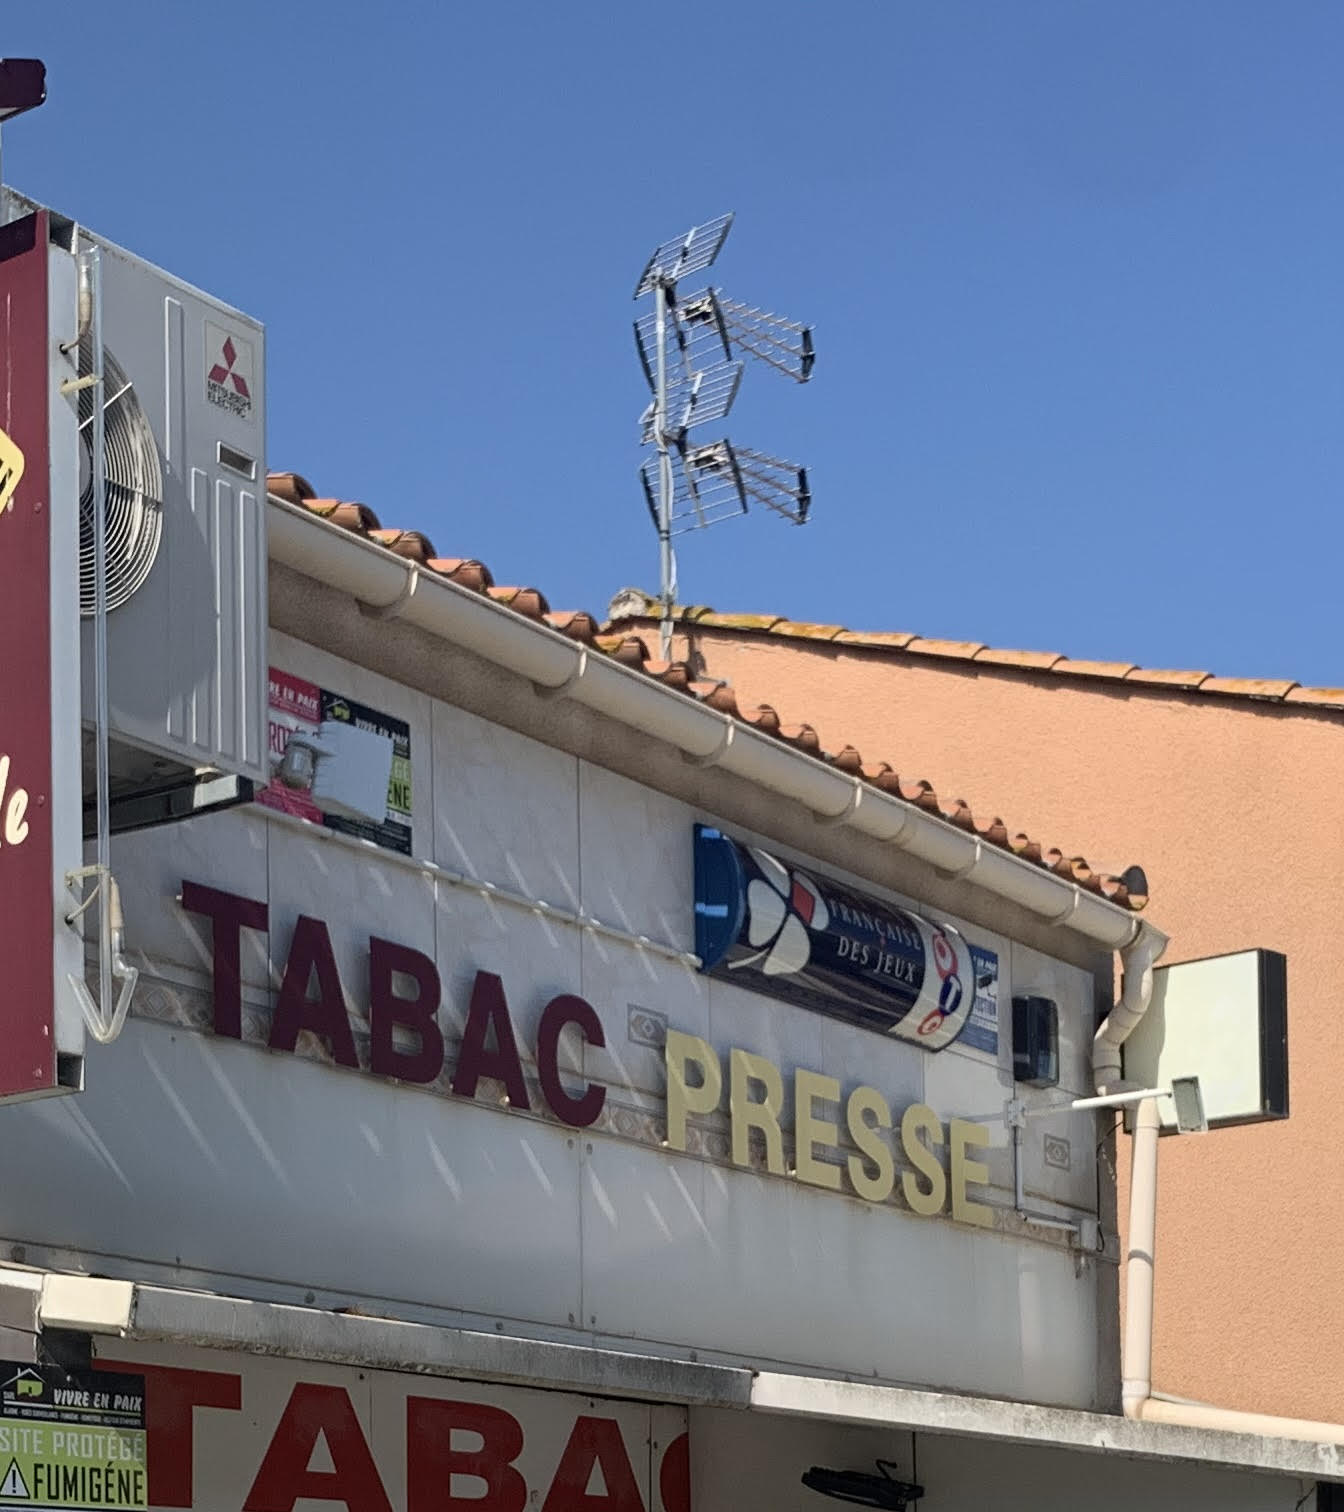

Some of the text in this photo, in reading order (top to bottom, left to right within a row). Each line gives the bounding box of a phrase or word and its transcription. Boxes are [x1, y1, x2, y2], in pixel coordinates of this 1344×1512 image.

[829, 900, 921, 950] FRANÇAISE
[838, 936, 915, 983] DES JEUX
[180, 881, 607, 1128] TABAC
[666, 1029, 994, 1227] PRESSE
[54, 1389, 142, 1412] VIVRE EN PAIX
[53, 1430, 144, 1462] PROTÉGÉ
[33, 1461, 144, 1505] FUMIGÉNE
